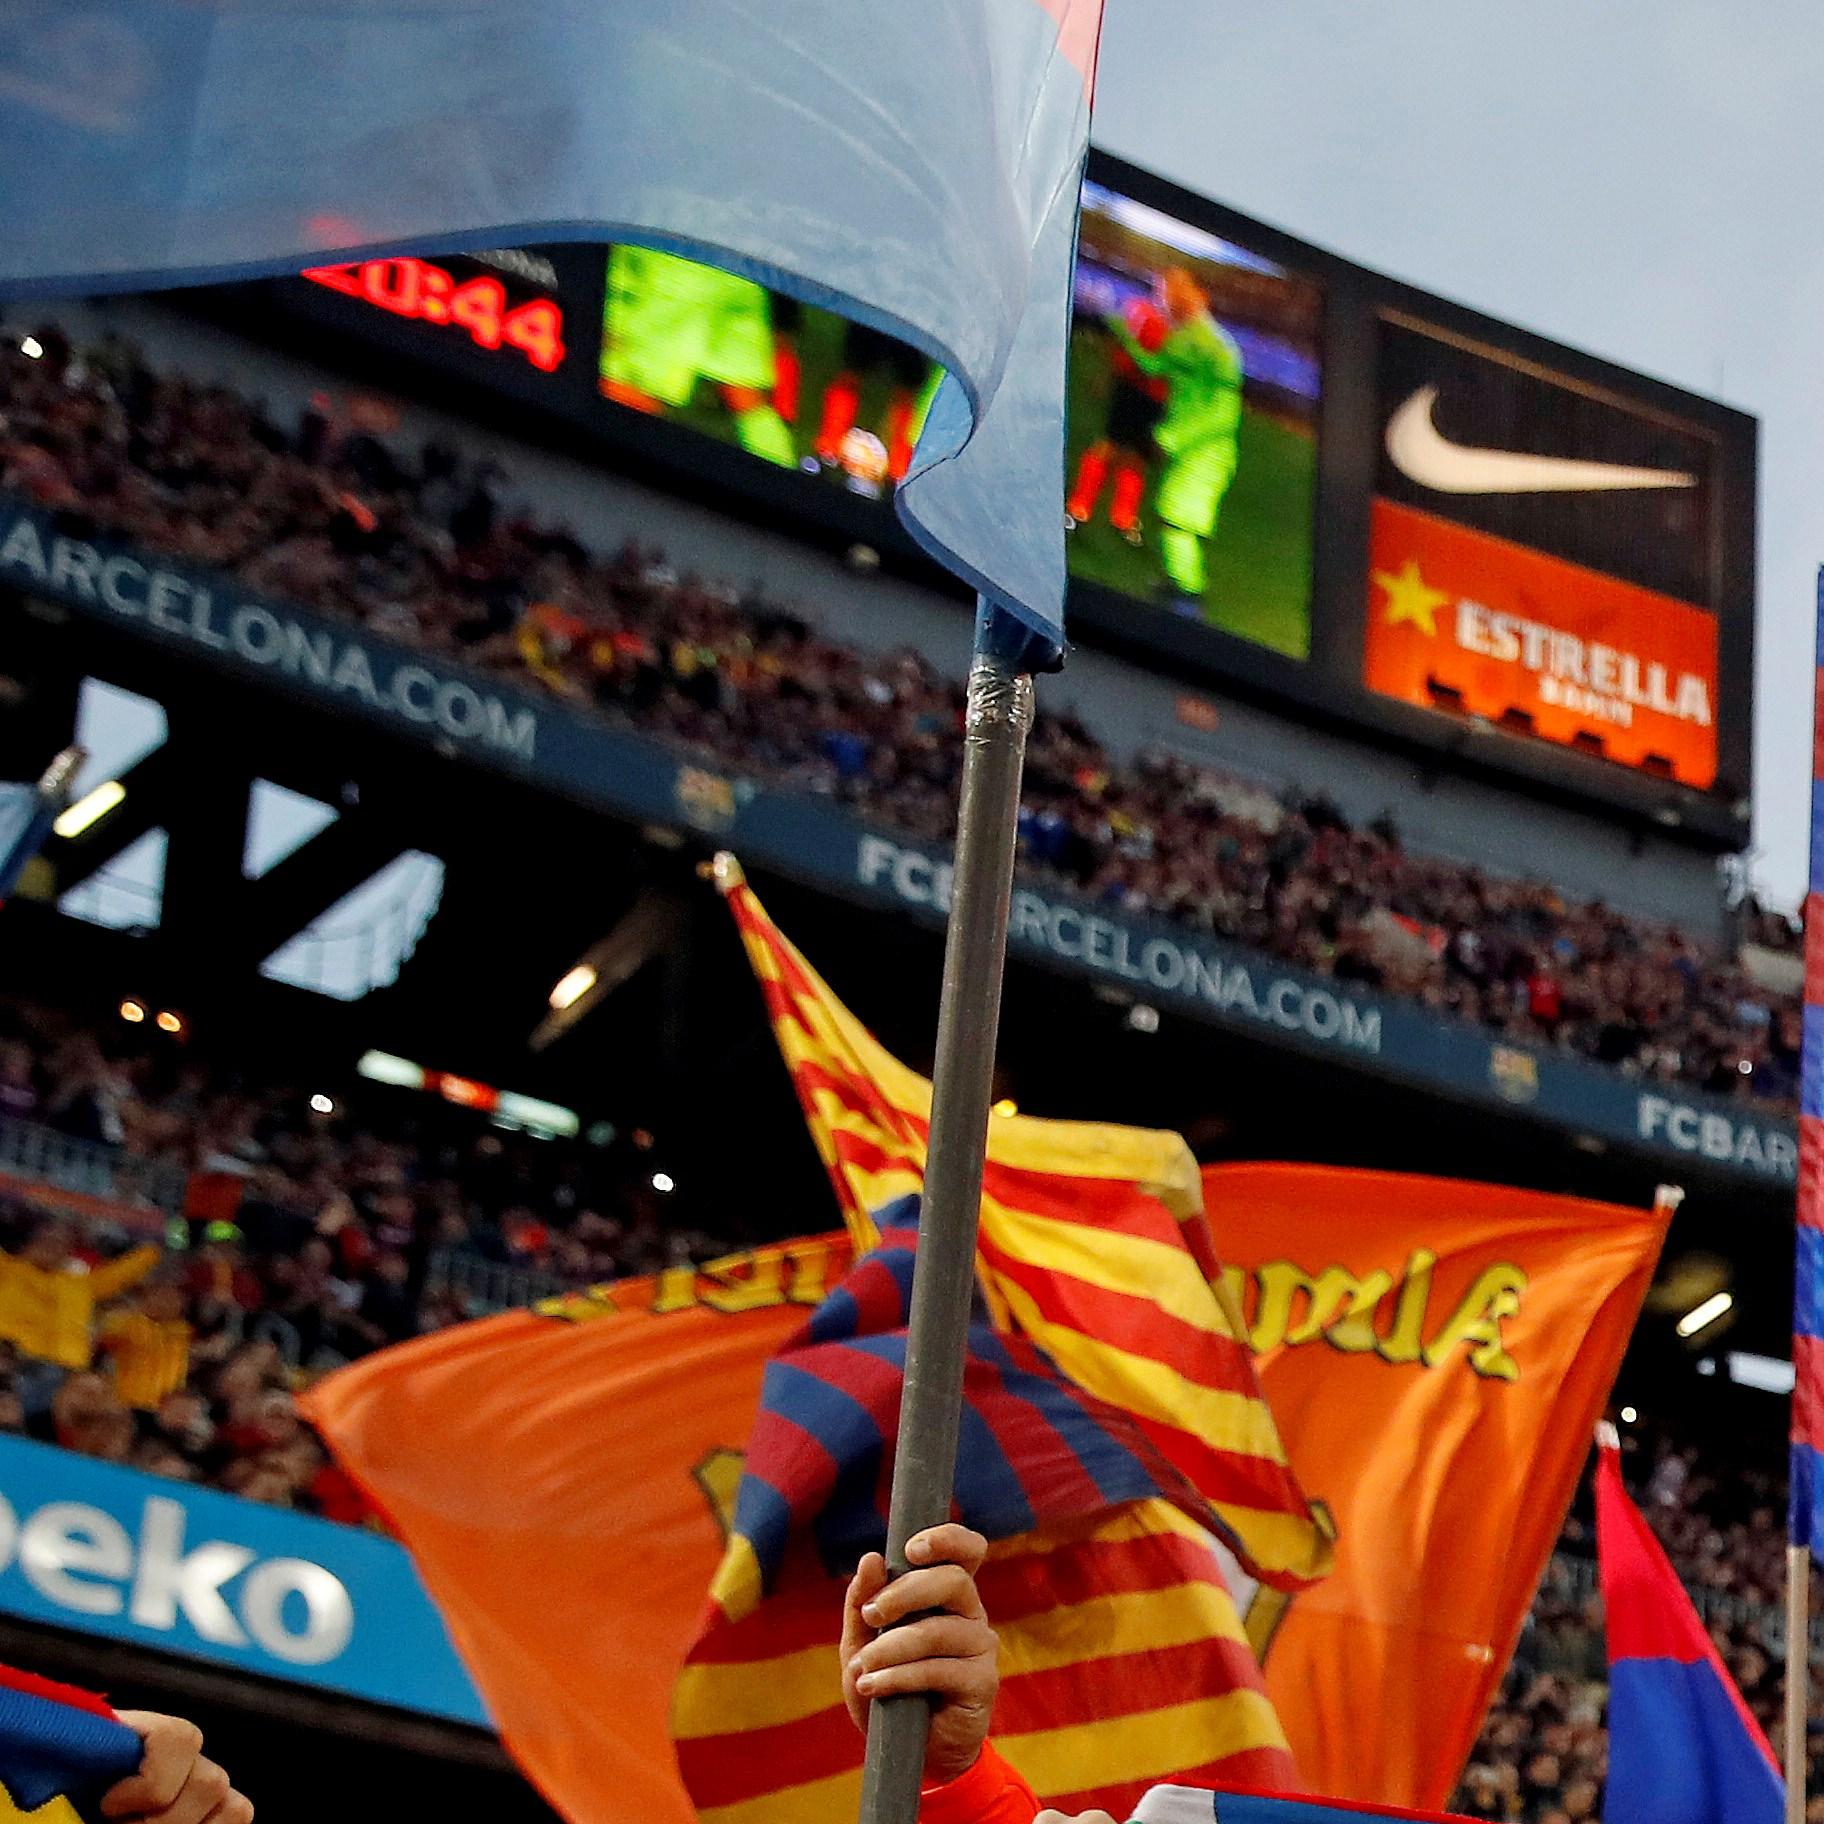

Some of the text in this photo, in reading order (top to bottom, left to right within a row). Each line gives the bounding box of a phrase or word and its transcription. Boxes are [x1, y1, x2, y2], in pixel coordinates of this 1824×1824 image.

[1456, 598, 1712, 726] ESTRELLA
[857, 834, 1382, 1054] FCRCELONA.COM
[0, 1496, 355, 1666] eko
